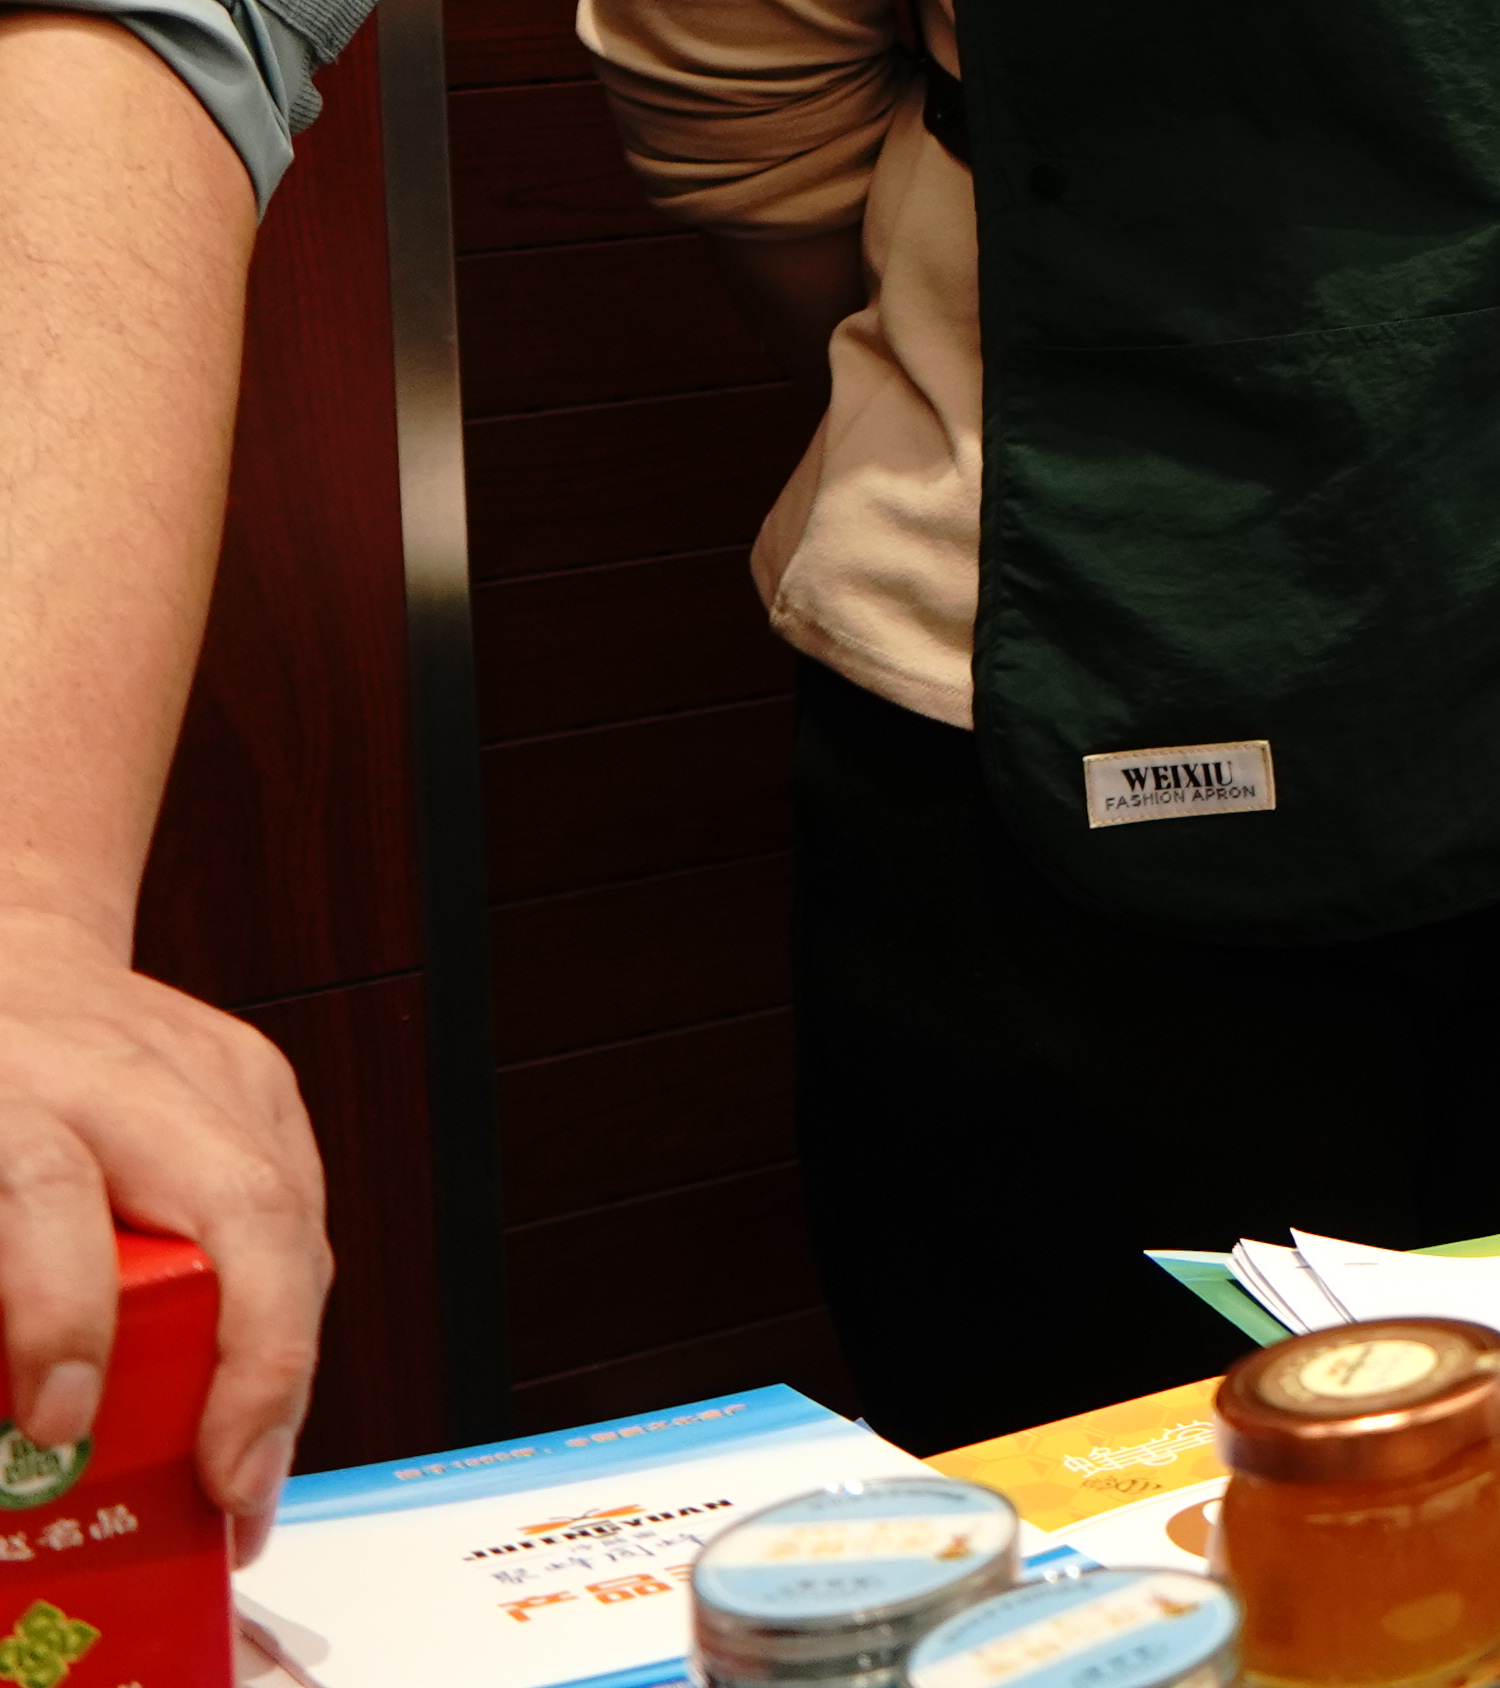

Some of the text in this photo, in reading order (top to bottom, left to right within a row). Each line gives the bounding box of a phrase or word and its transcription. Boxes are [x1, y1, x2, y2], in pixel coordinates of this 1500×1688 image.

[1121, 761, 1234, 793] WEIXIU
[1105, 785, 1257, 812] FASHION APRON
